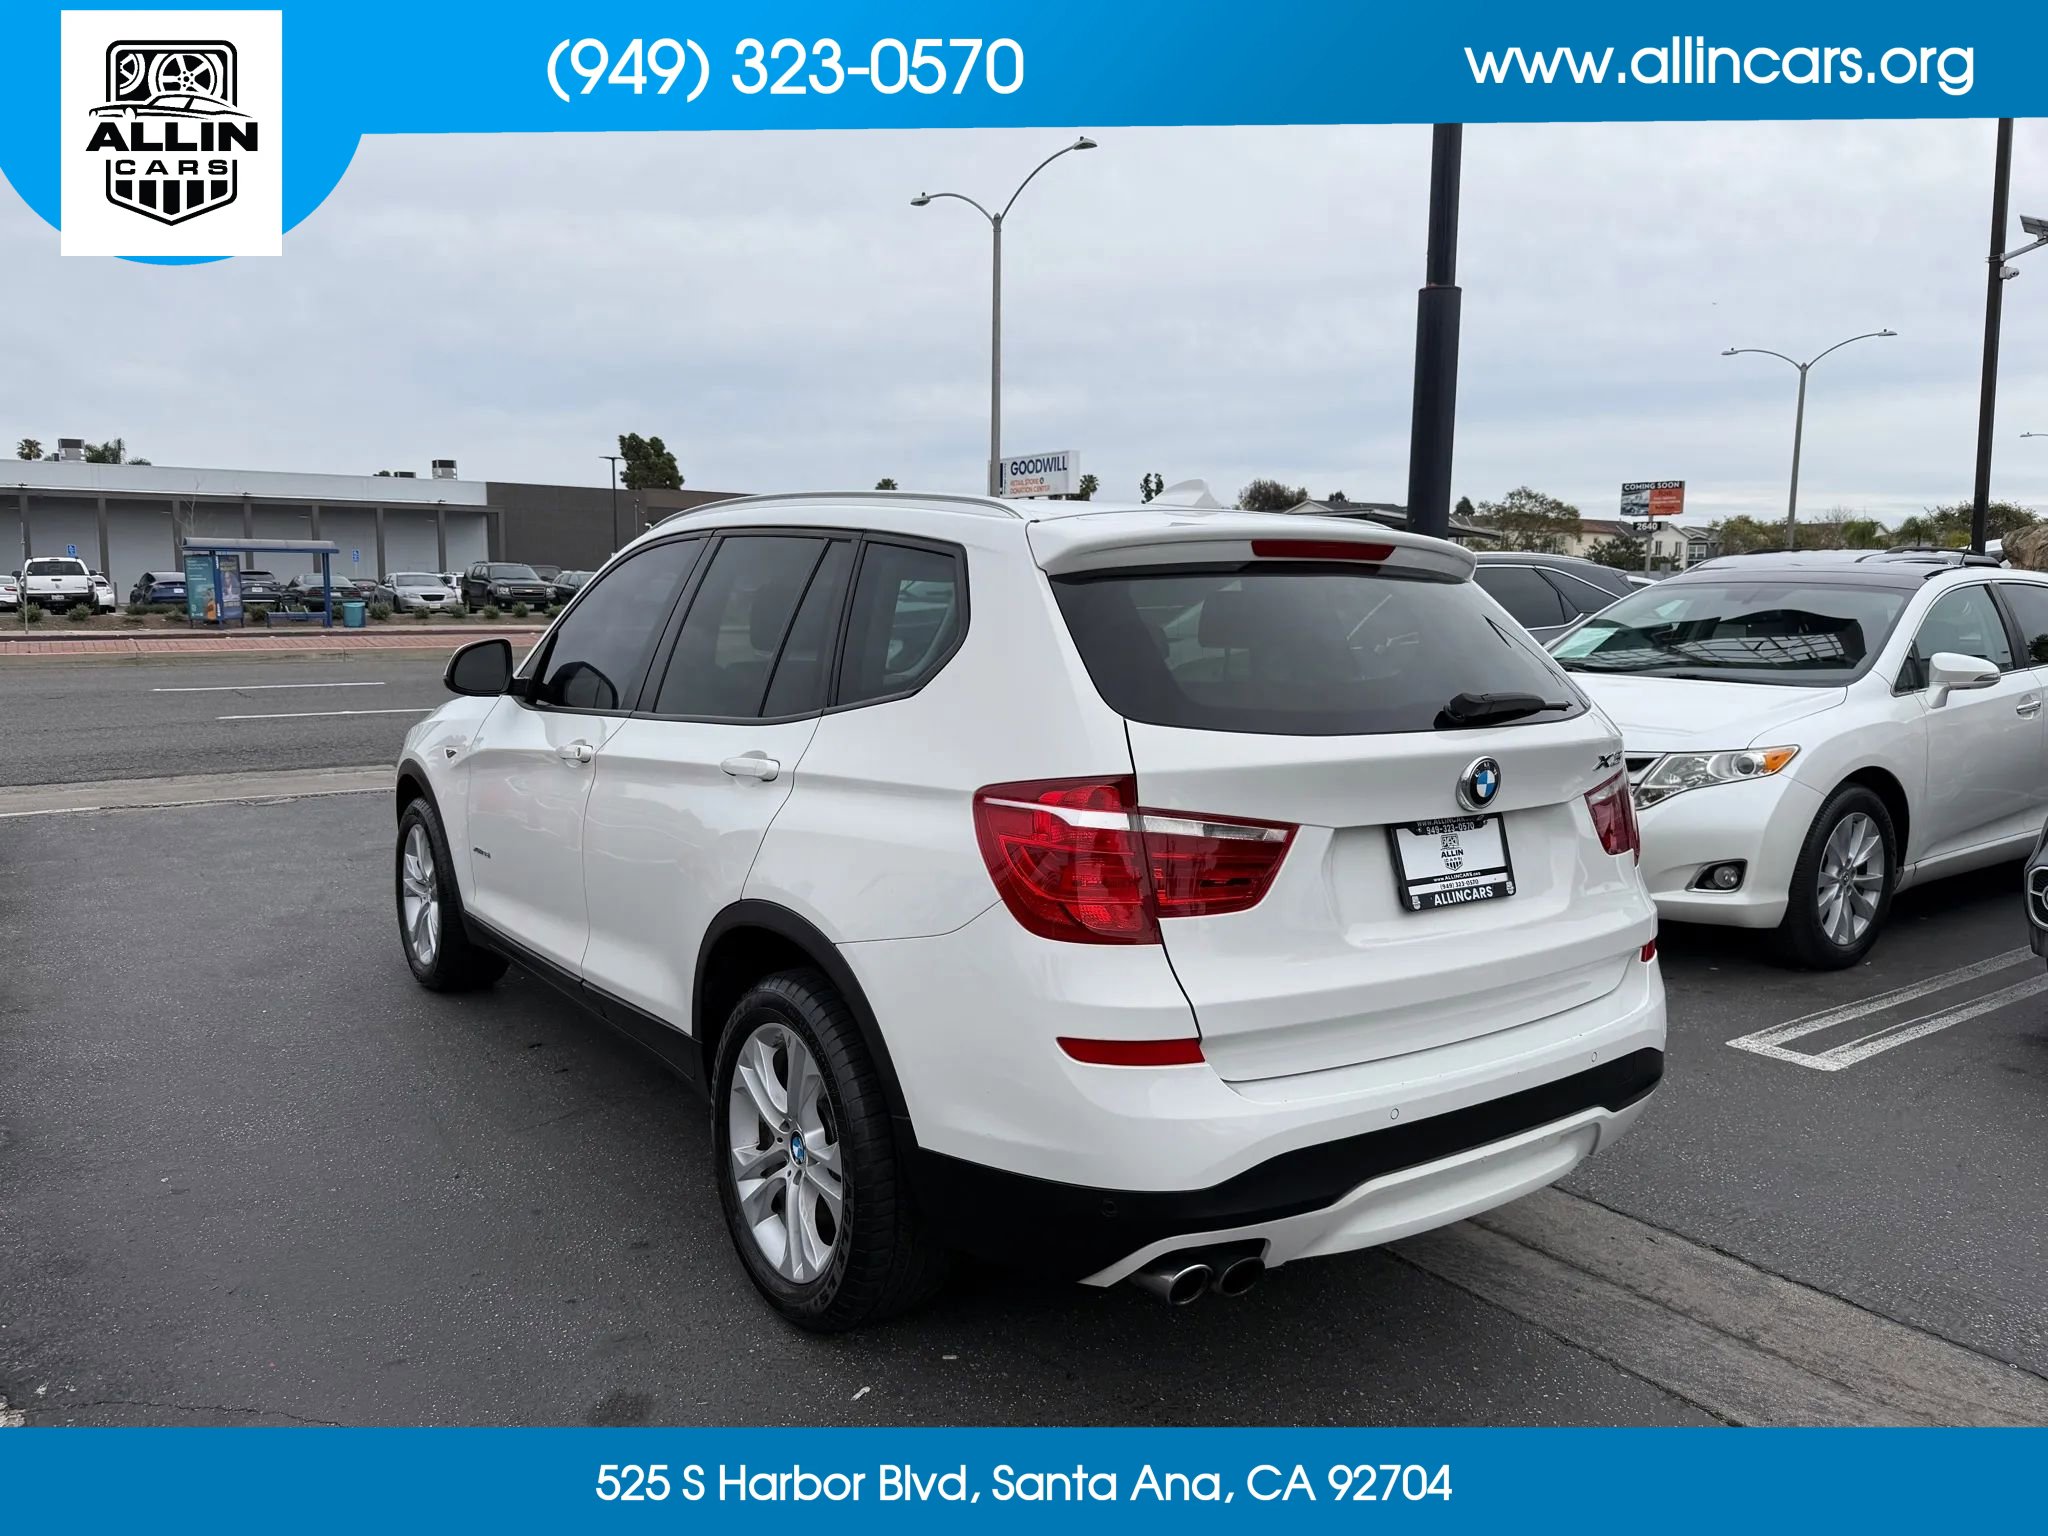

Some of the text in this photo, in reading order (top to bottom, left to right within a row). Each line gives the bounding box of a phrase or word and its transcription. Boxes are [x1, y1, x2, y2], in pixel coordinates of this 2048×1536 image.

[1011, 456, 1068, 476] GOODWILL
[1624, 481, 1680, 491] COMING SOON
[1636, 523, 1658, 531] 2640
[1426, 822, 1475, 835] 949-323-0570
[1440, 848, 1464, 859] ALLIN
[1434, 885, 1494, 906] ALLINCARS
